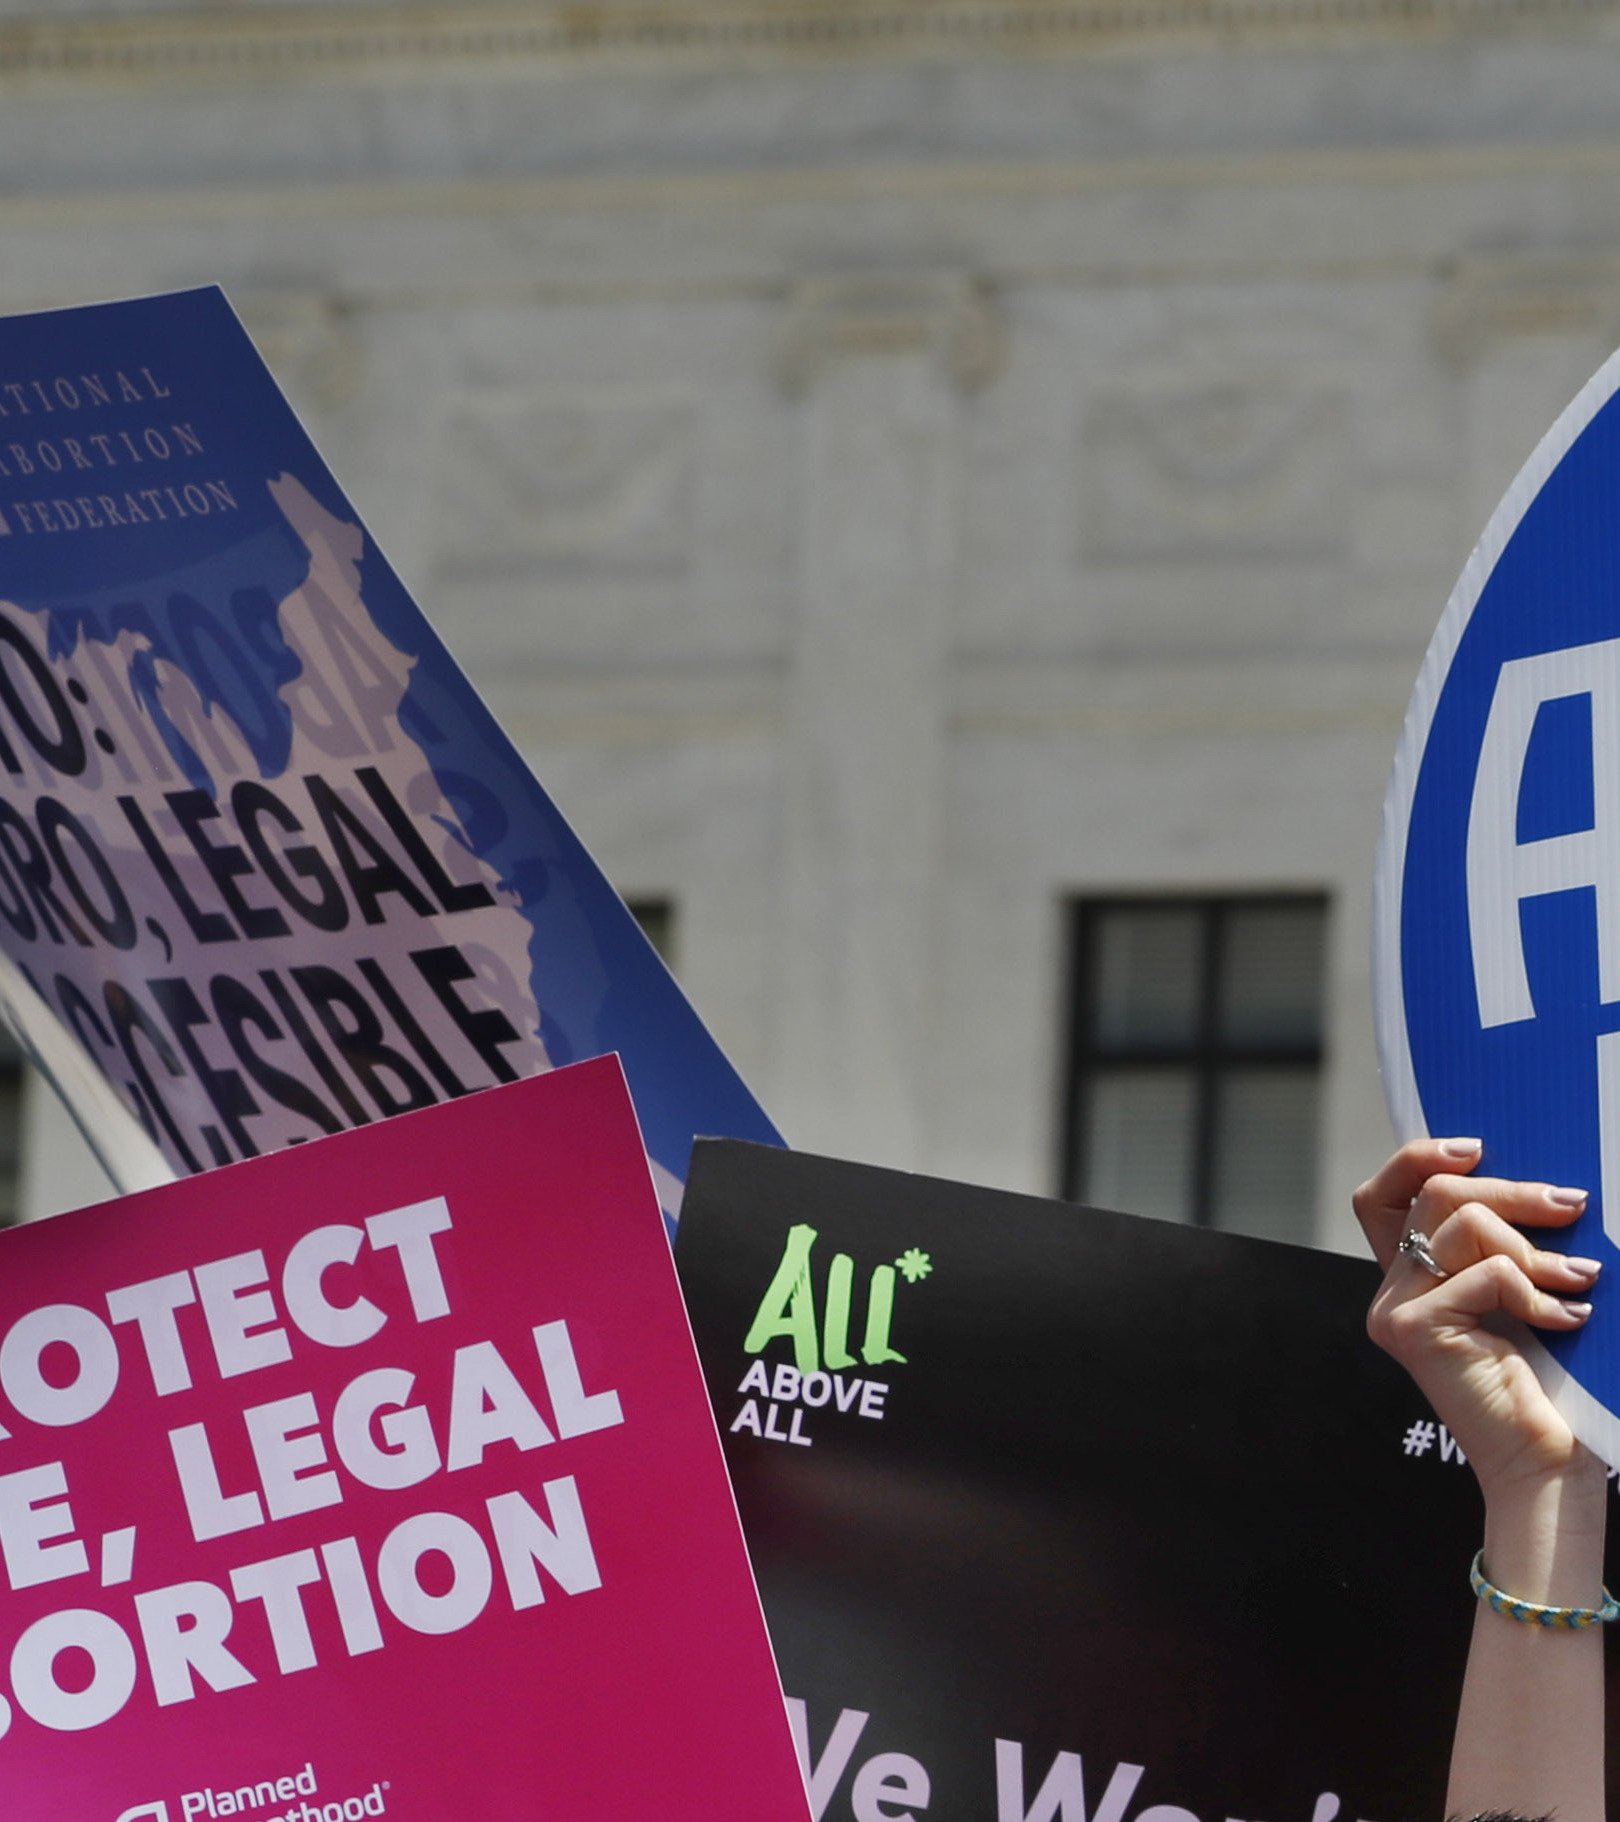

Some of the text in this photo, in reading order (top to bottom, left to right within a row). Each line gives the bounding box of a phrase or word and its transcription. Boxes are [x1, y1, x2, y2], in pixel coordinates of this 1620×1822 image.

[13, 480, 238, 534] FEDERATION
[0, 612, 116, 777] O:
[0, 767, 497, 962] RO, LEGAL
[0, 1196, 454, 1440] OTECT
[737, 1359, 889, 1419] ABOVE
[168, 1319, 625, 1542] LEGAL
[729, 1399, 812, 1446] ALL
[0, 1475, 603, 1741] ORTION
